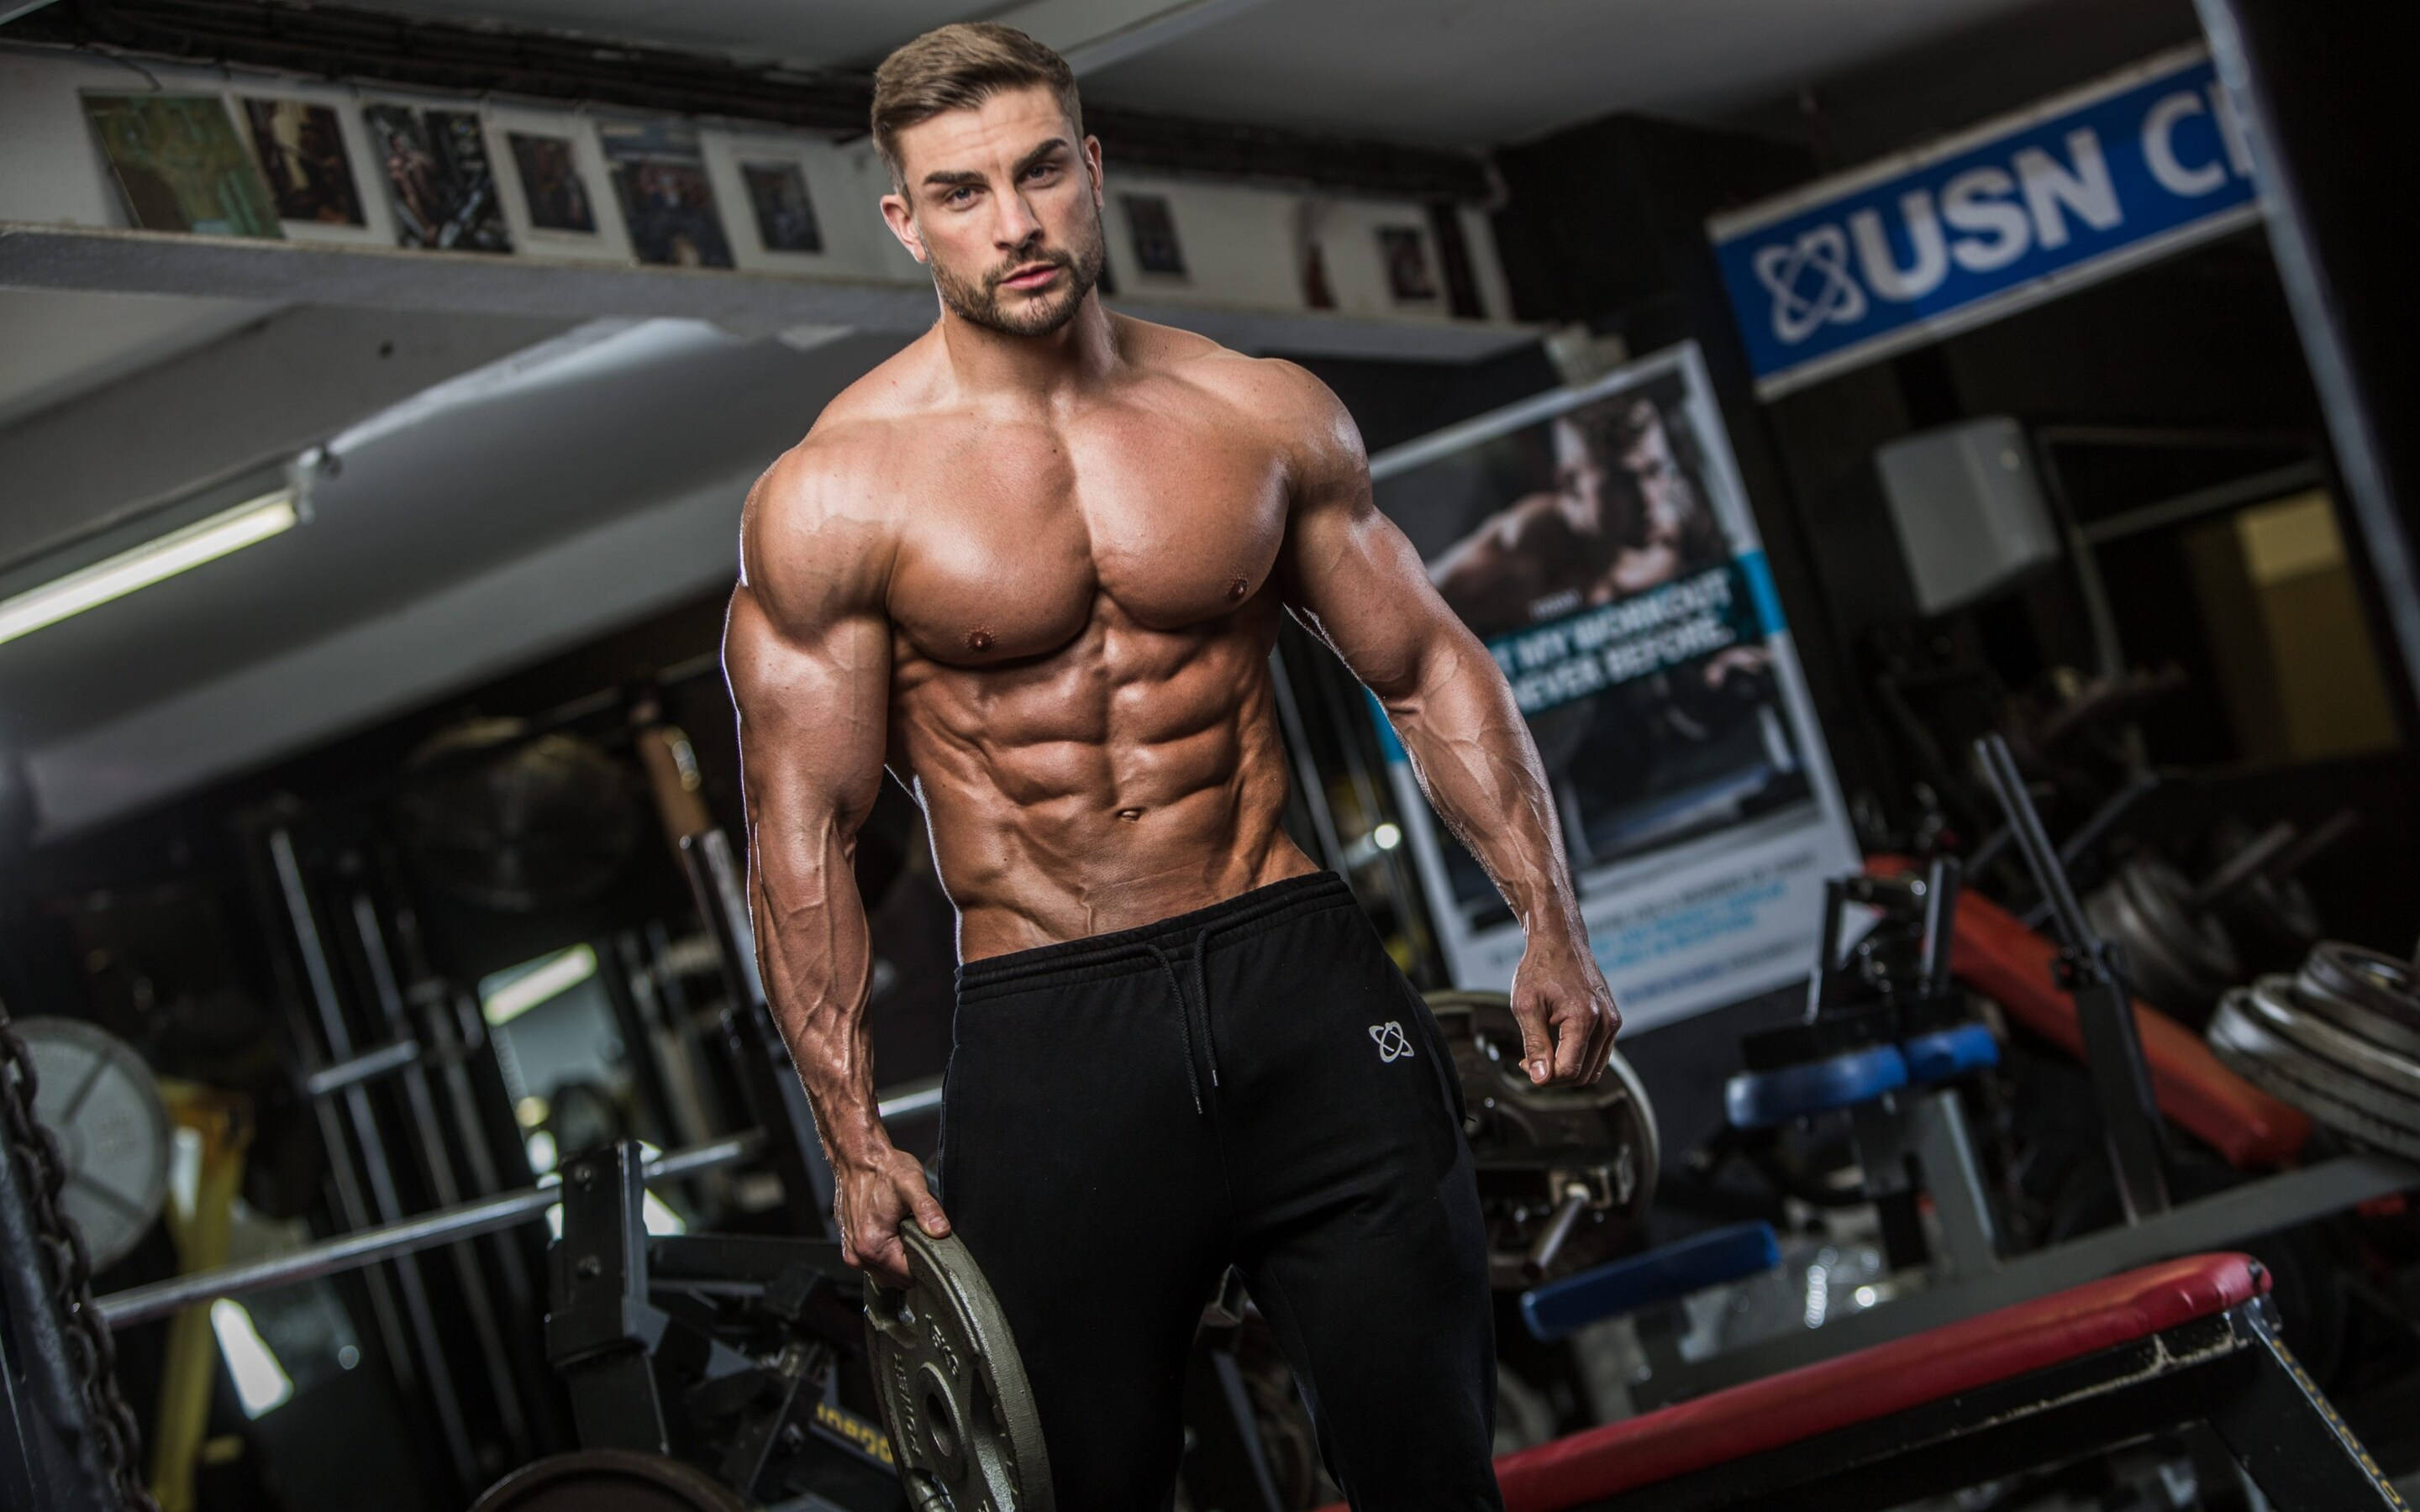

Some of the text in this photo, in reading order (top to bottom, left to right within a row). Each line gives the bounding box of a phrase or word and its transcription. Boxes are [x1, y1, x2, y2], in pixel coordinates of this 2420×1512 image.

[1851, 127, 2123, 302] USN
[1516, 629, 1567, 667] MY
[1573, 569, 1732, 649] WORKOUT
